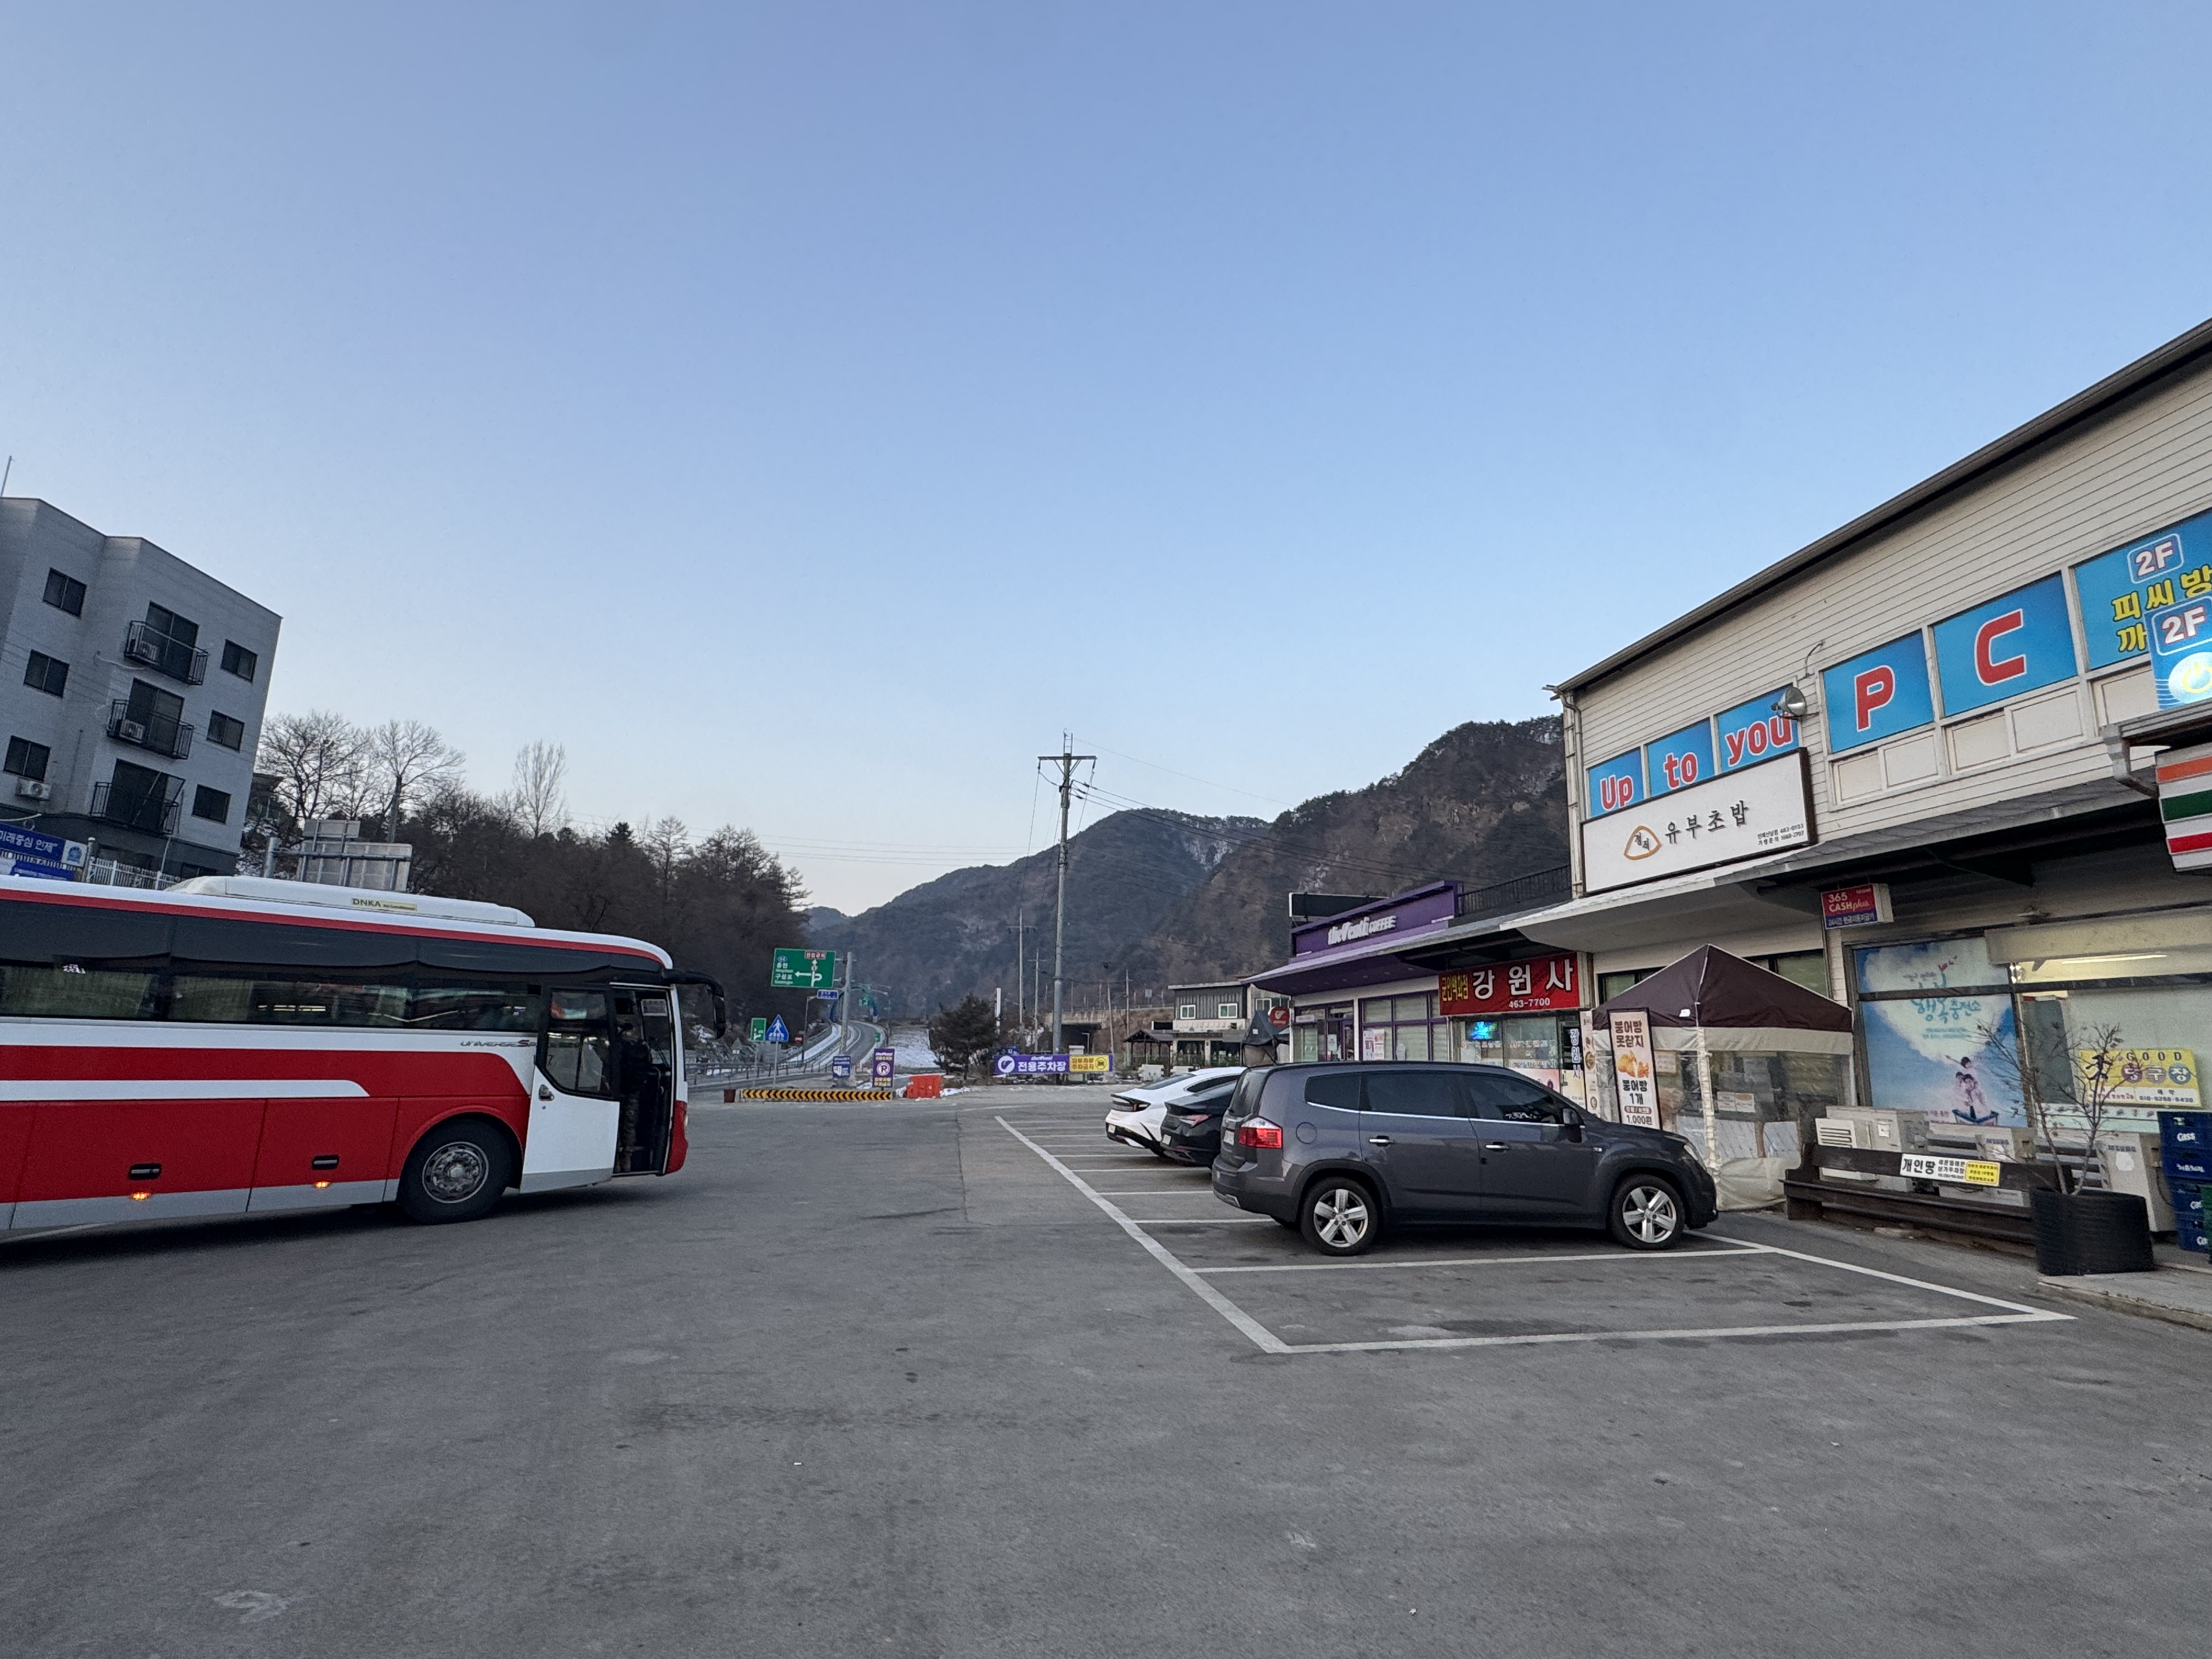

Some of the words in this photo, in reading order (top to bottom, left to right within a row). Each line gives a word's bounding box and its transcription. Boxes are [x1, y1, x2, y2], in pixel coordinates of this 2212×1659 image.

[2135, 540, 2174, 577] 2F
[2112, 564, 2212, 622] 피씨방
[2162, 606, 2207, 645] 2F
[1600, 775, 1633, 810] Up
[1663, 752, 1698, 789] to
[1725, 713, 1793, 767] you
[1665, 800, 1750, 844] 유부초밥
[1829, 892, 1847, 903] 365
[1472, 959, 1573, 999] 강원사
[1509, 998, 1550, 1008] 463-7700
[1615, 1020, 1643, 1034] 붕어빵
[1616, 1035, 1644, 1048] 못참지
[2126, 1052, 2182, 1060] GOOD
[1018, 1062, 1066, 1071] 전용주차장
[1622, 1080, 1647, 1092] 붕어빵
[1902, 1159, 1936, 1175] 개인땅
